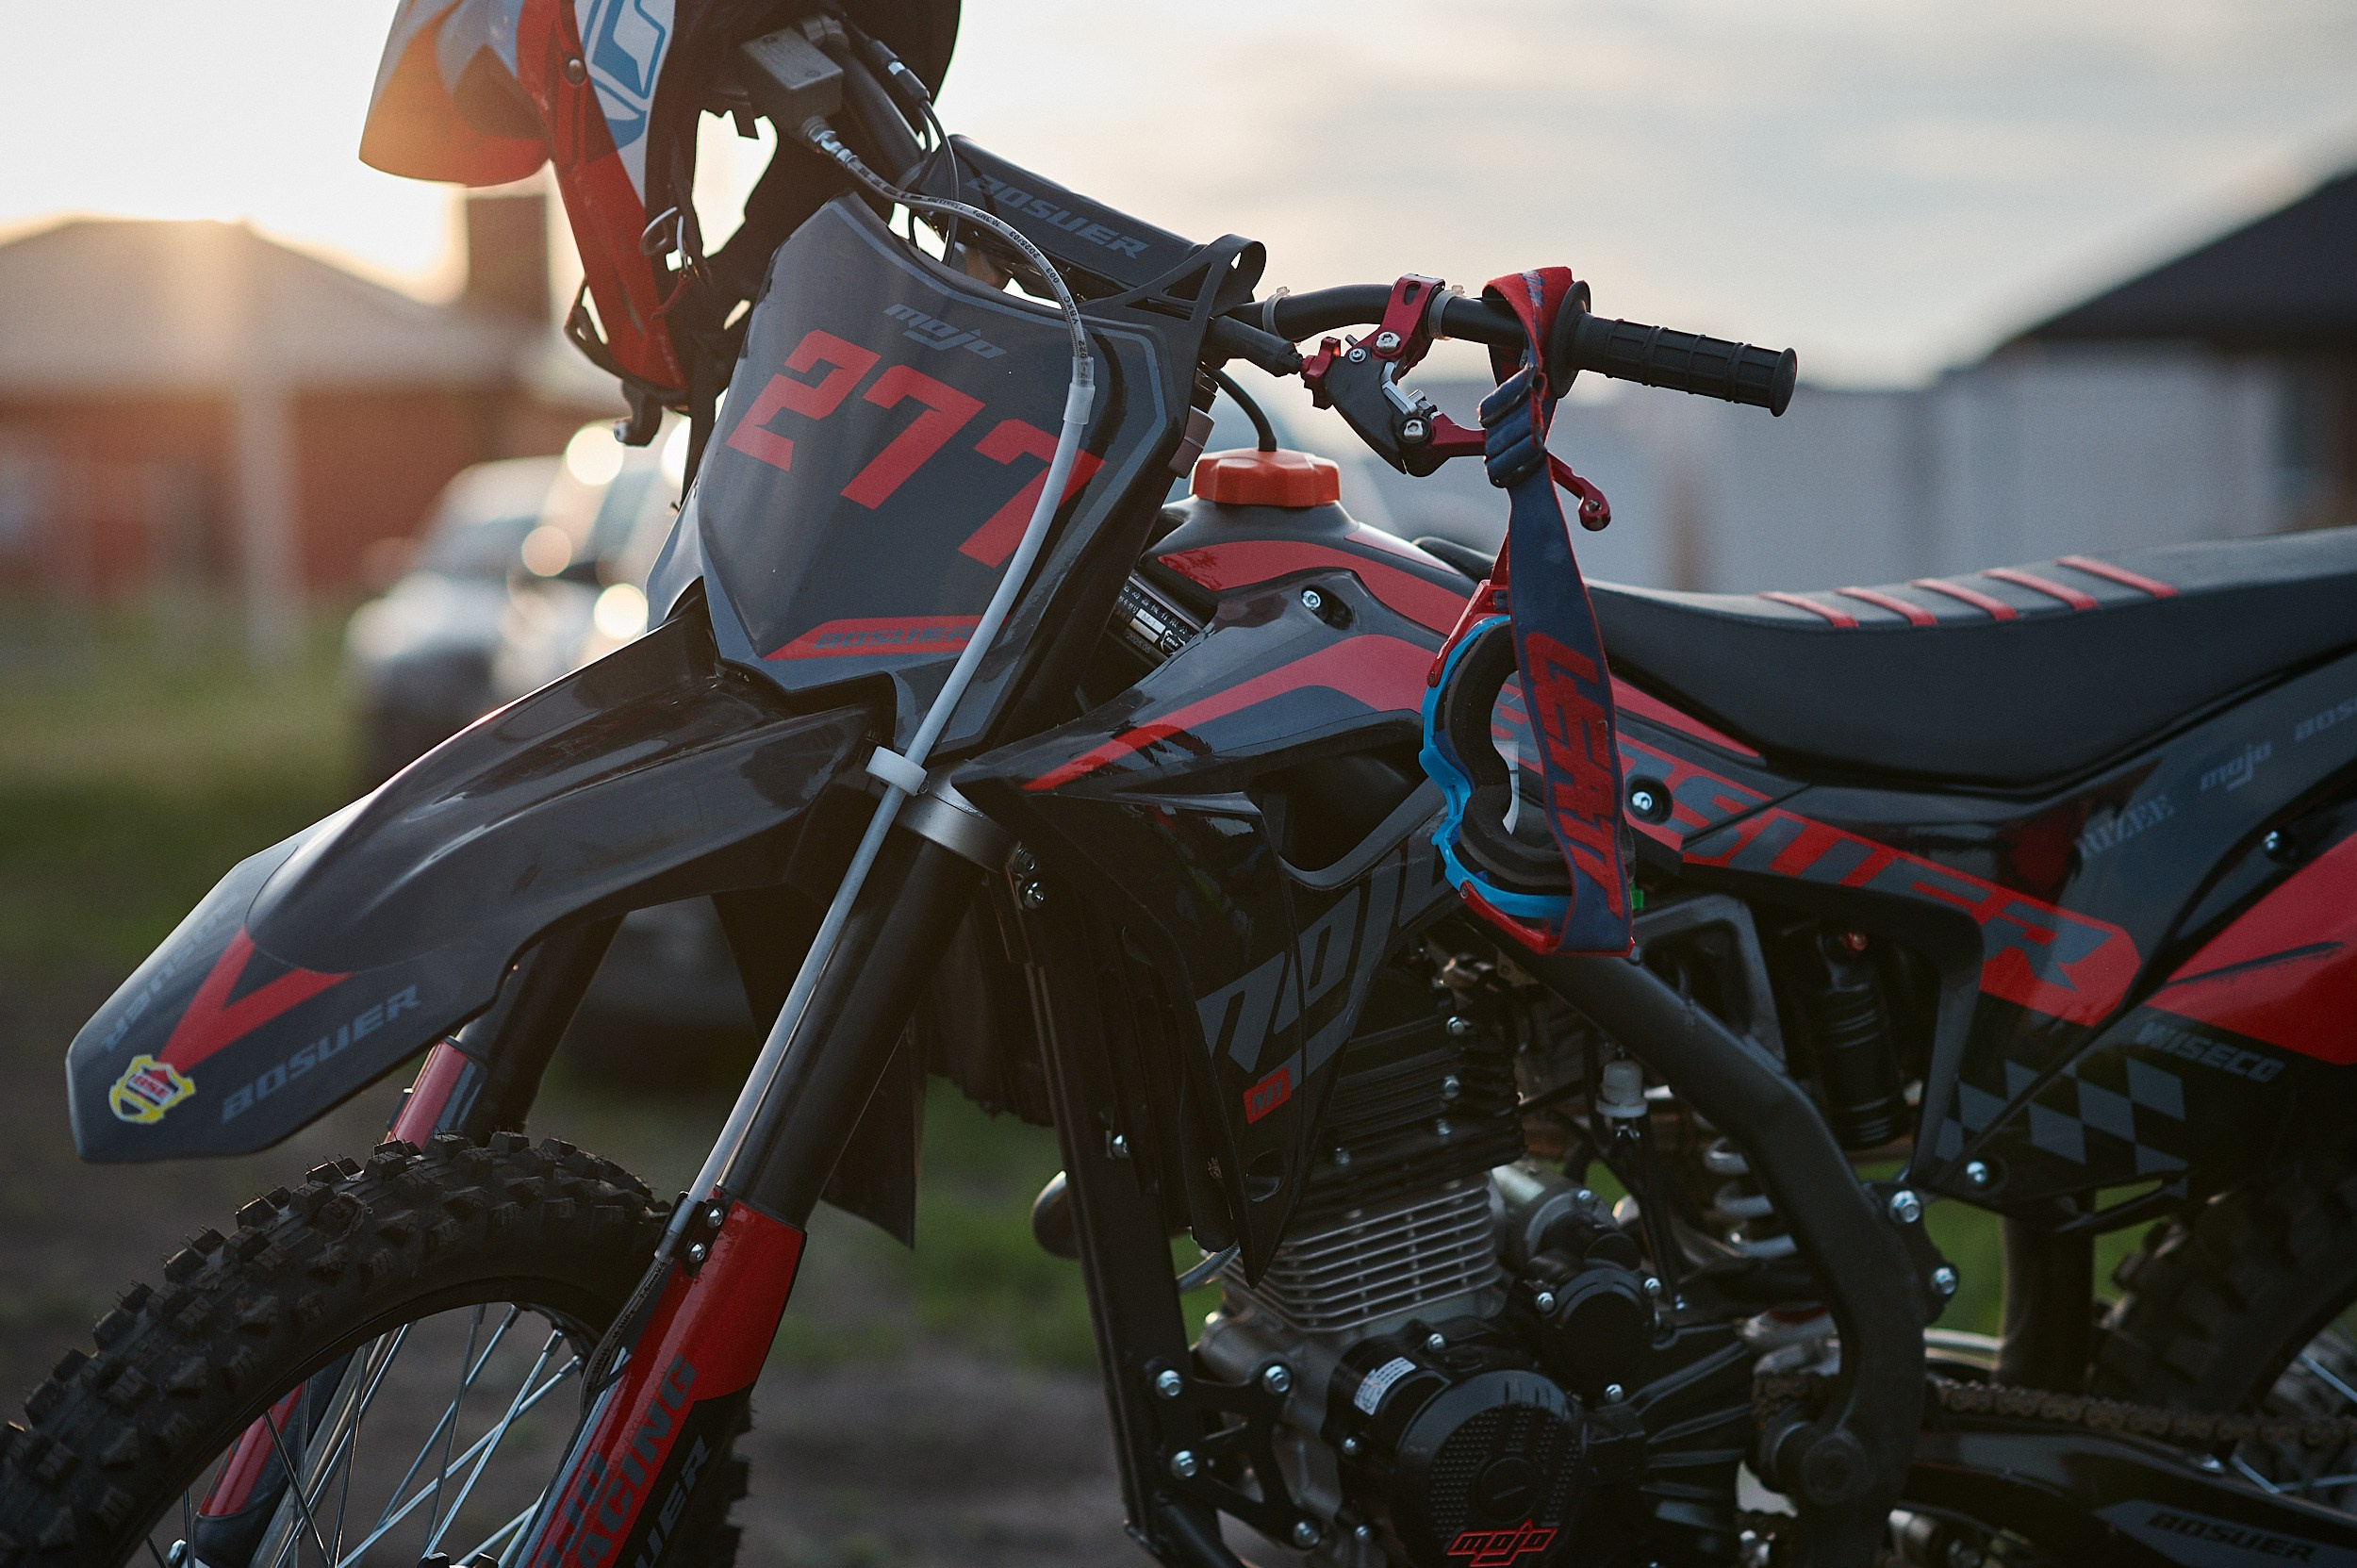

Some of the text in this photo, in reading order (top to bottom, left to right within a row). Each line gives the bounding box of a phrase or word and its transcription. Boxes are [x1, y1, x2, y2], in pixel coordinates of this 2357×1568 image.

[965, 174, 1149, 258] BOSUER
[1009, 230, 1041, 259] 2025/03
[1046, 267, 1060, 284] 003
[726, 330, 1106, 568] 277
[812, 625, 974, 650] BOSUER
[1492, 686, 2114, 992] SUER
[221, 984, 422, 1124] BOSUER
[2135, 1023, 2285, 1081] WISECO
